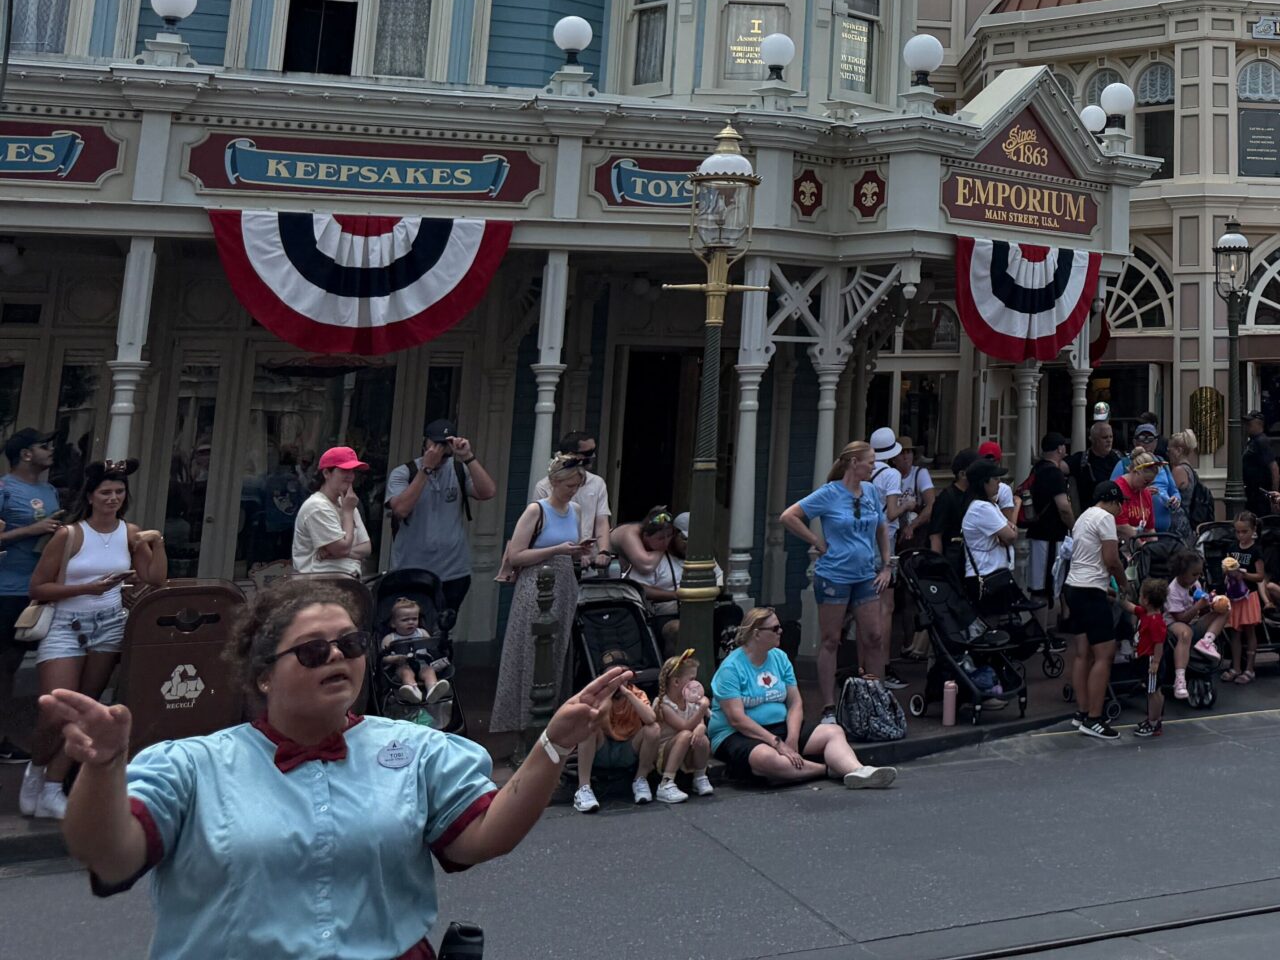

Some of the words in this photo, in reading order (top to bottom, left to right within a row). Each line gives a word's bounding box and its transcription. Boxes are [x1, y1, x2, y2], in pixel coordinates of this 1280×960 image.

[1003, 125, 1038, 149] Since
[0, 143, 56, 163] ES
[1018, 143, 1049, 167] 1863
[266, 158, 473, 186] KEEPSAKES
[631, 177, 701, 198] TOYS
[955, 176, 1087, 222] EMPORIUM
[984, 208, 1007, 221] MAIN
[1008, 212, 1040, 227] STREET,
[1041, 216, 1060, 228] U.S.A.
